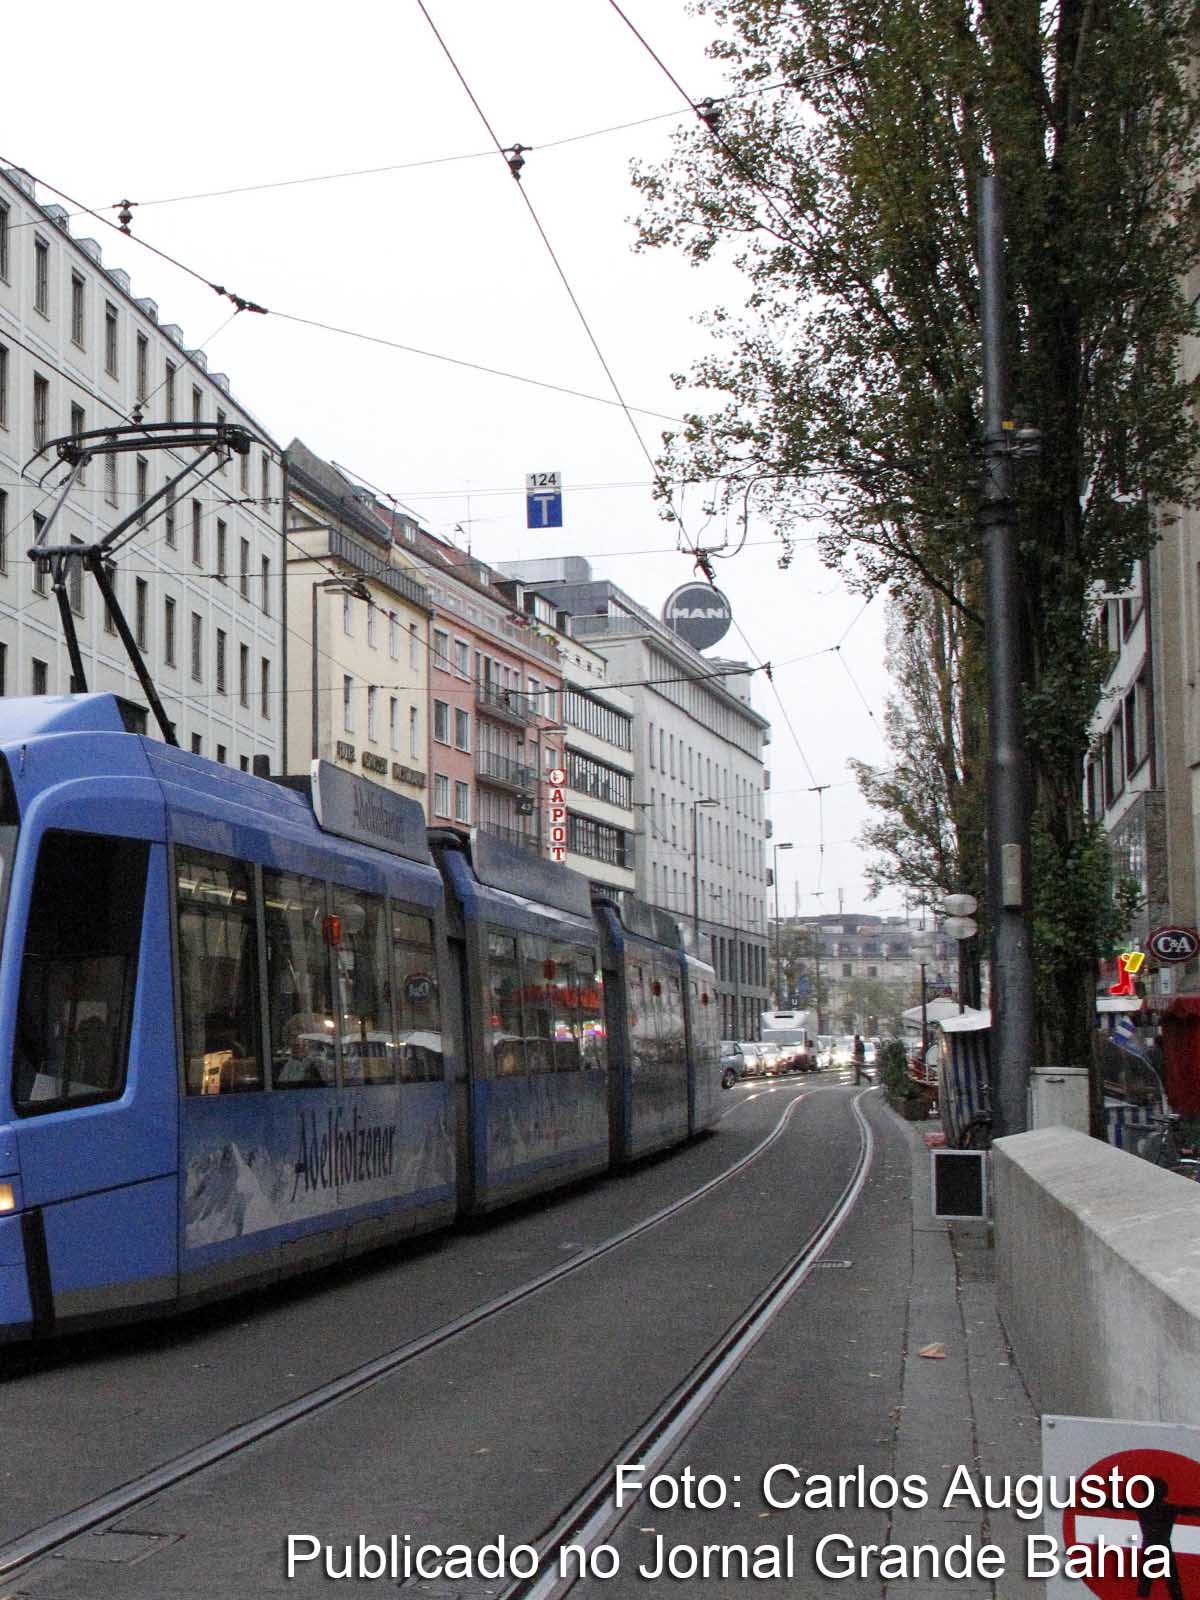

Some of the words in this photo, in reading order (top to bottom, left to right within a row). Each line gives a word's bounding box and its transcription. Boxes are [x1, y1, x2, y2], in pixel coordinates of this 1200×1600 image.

[530, 473, 557, 486] 124
[533, 495, 556, 526] T
[671, 607, 724, 619] MAN
[1157, 936, 1192, 953] C&A
